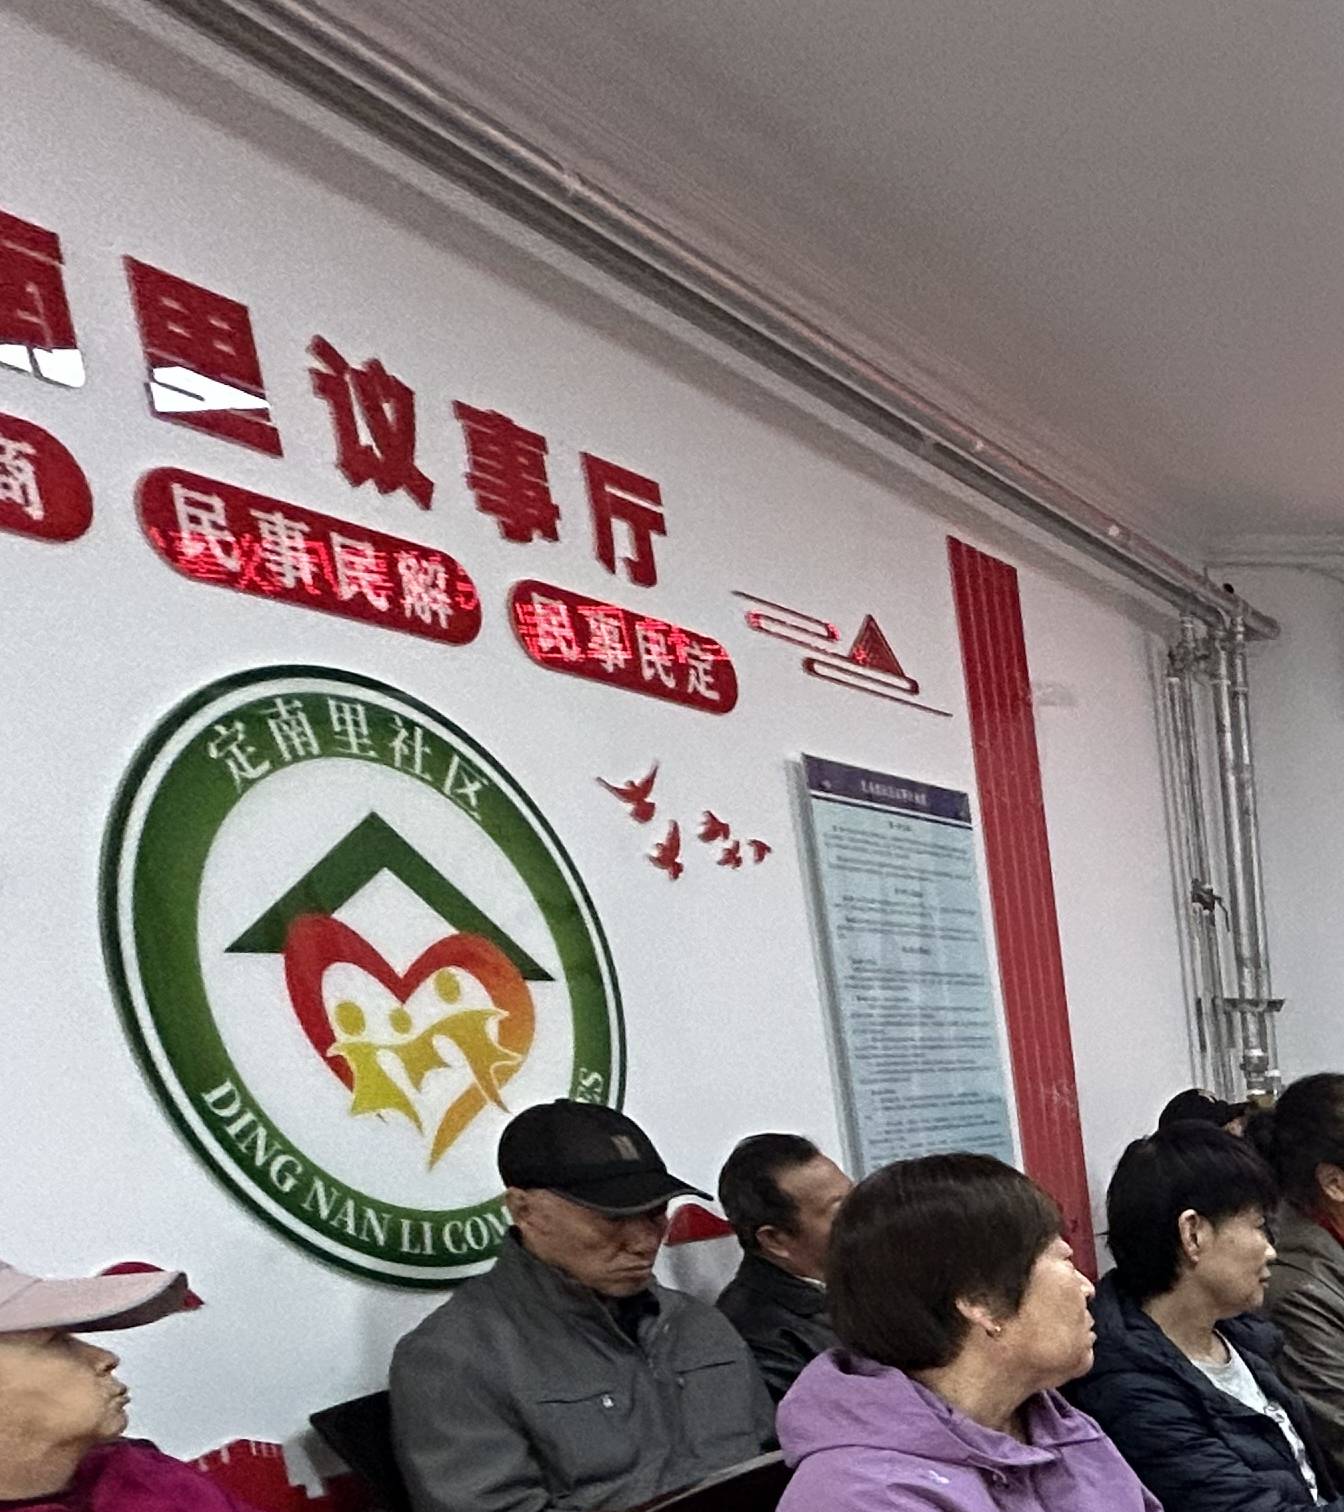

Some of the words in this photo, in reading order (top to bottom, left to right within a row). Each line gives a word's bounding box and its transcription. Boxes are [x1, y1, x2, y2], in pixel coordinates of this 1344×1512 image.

[208, 697, 489, 820] 定南里社区
[201, 1077, 303, 1193] DING
[302, 1177, 391, 1247] NAN
[400, 1218, 436, 1255] LI
